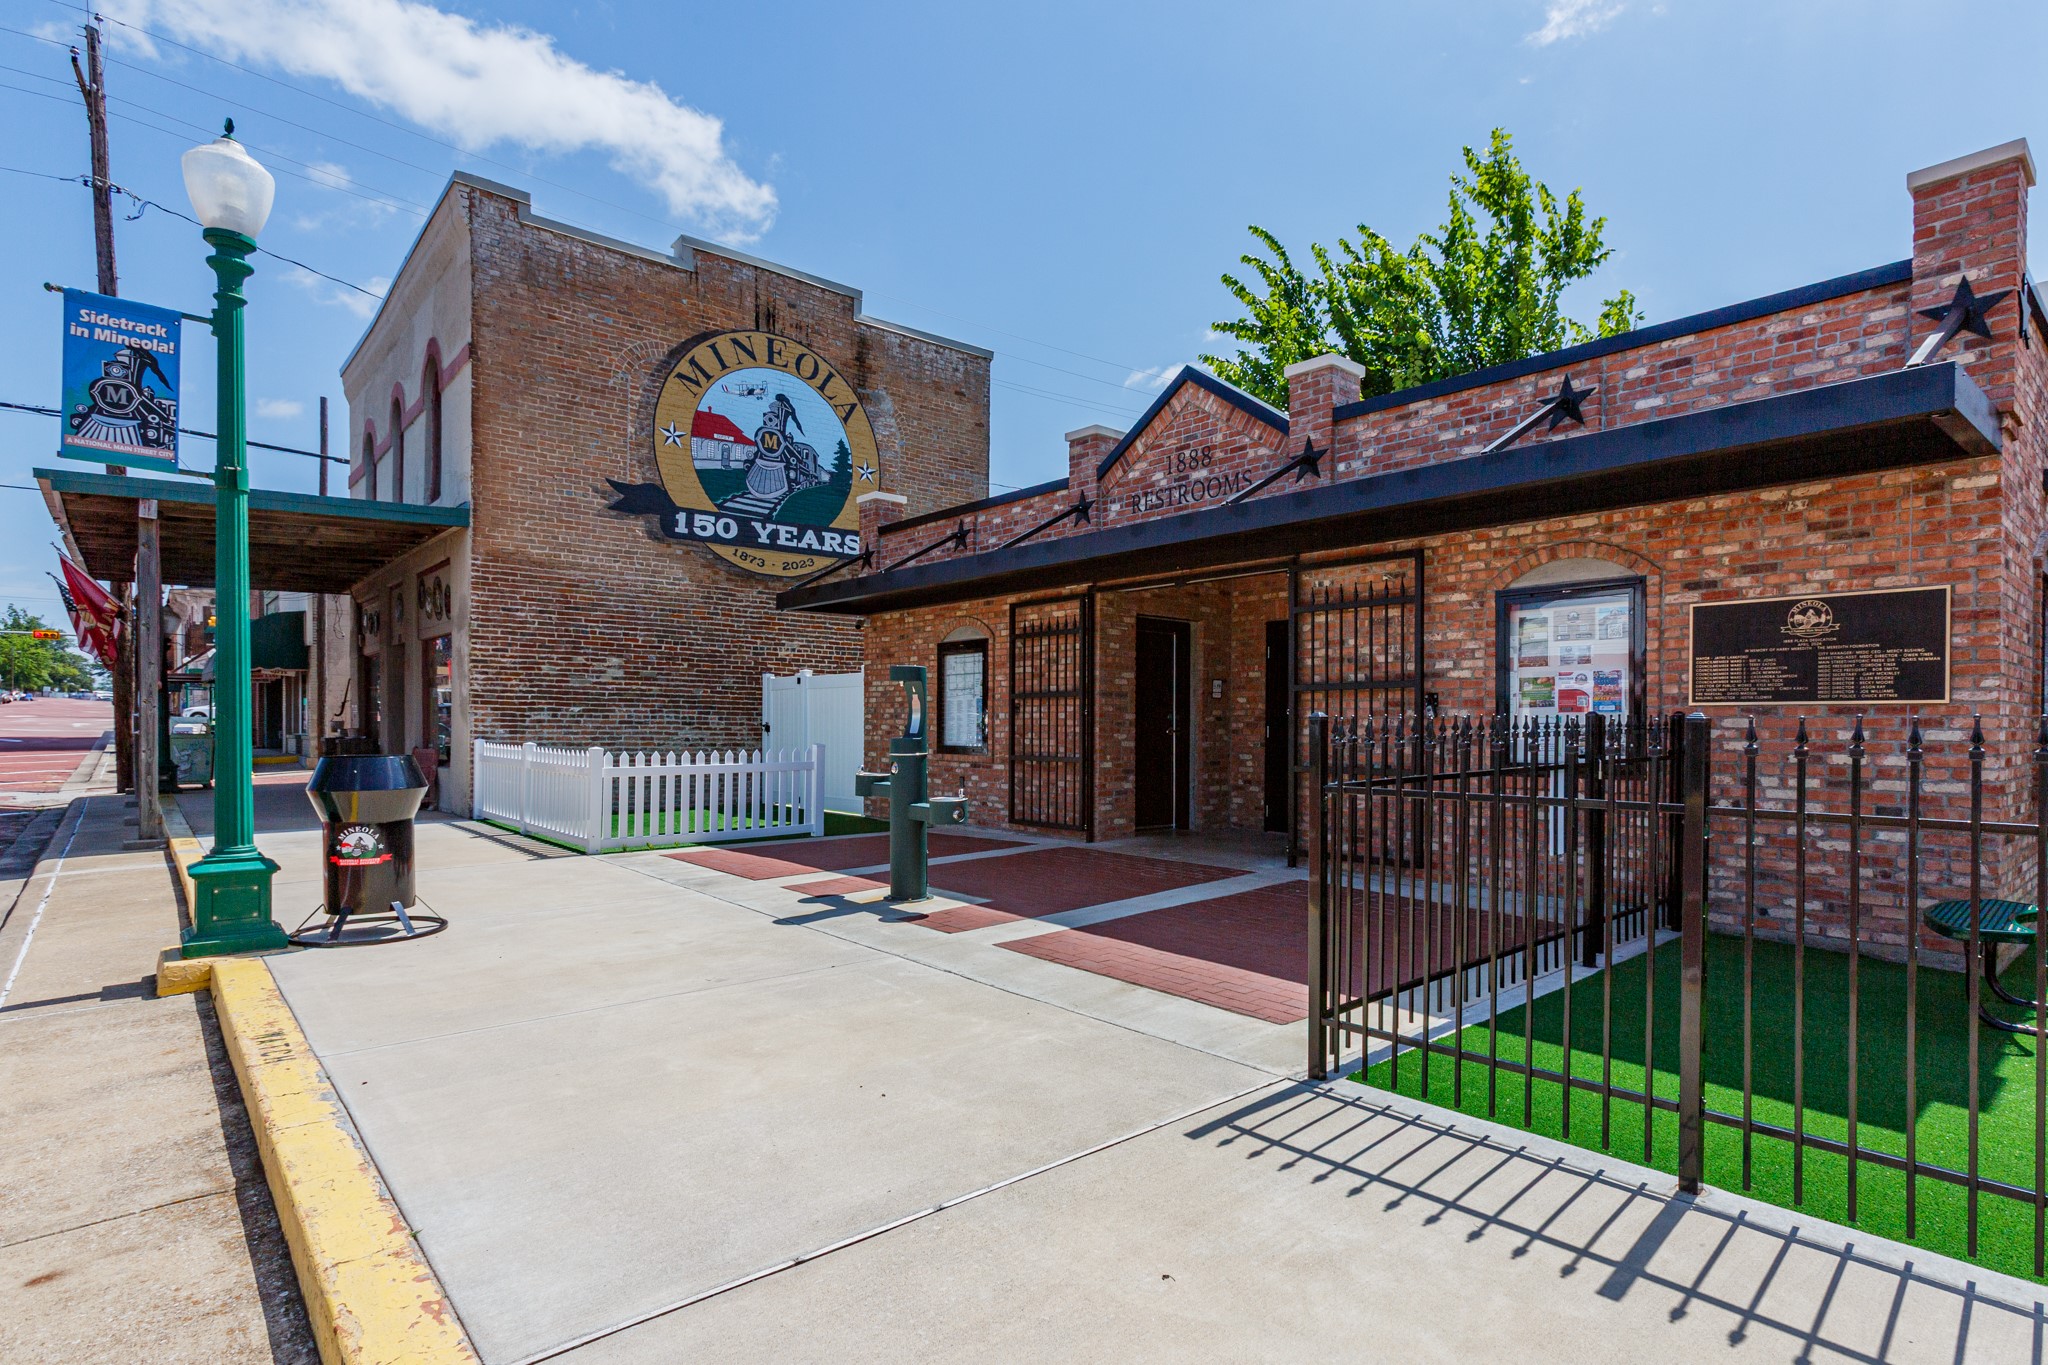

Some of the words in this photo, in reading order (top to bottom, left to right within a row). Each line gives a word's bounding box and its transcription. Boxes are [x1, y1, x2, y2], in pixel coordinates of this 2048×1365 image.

[70, 322, 90, 338] in
[94, 327, 175, 354] Mineola!
[79, 309, 168, 338] Sidetrack
[105, 385, 129, 405] M
[673, 335, 859, 426] MINEOLA
[74, 437, 112, 449] NATIONAL
[113, 444, 133, 452] MAIN
[133, 447, 158, 456] STREET
[763, 433, 779, 450] M
[1166, 445, 1212, 475] 1888
[1131, 469, 1253, 514] RESTROOMS
[674, 511, 739, 539] 150
[751, 521, 860, 555] YEARS
[732, 547, 765, 568] 1873
[782, 557, 815, 571] 2023
[338, 826, 380, 841] MINEOLA
